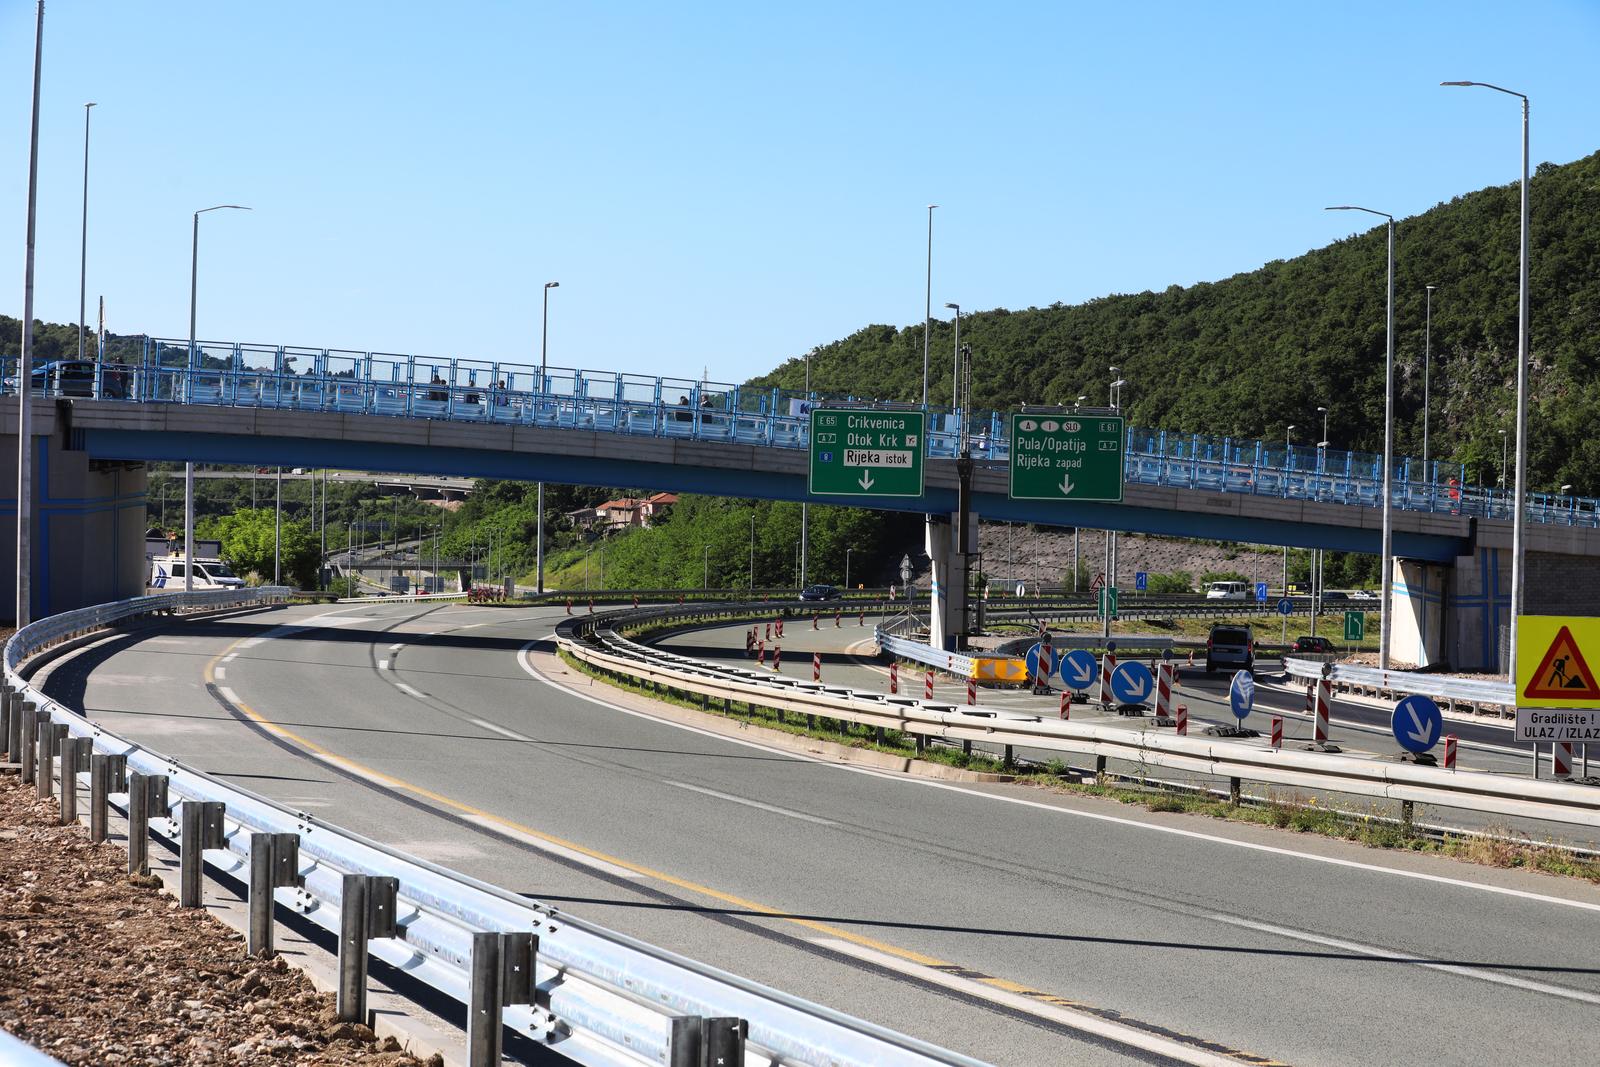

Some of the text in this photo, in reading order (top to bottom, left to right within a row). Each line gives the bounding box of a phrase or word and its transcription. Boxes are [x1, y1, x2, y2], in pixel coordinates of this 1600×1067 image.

[847, 415, 905, 429] Crikvenica
[1025, 422, 1031, 430] A
[1065, 423, 1078, 431] SLO
[847, 433, 898, 447] Otok Krk
[1017, 436, 1087, 454] Pula/Opatija
[847, 450, 907, 466] Rijeka istok
[1017, 454, 1082, 470] Rijeka zapad
[1531, 713, 1587, 725] Gradilište
[1524, 727, 1555, 738] ULAZ
[1566, 727, 1600, 739] IZLAZ
